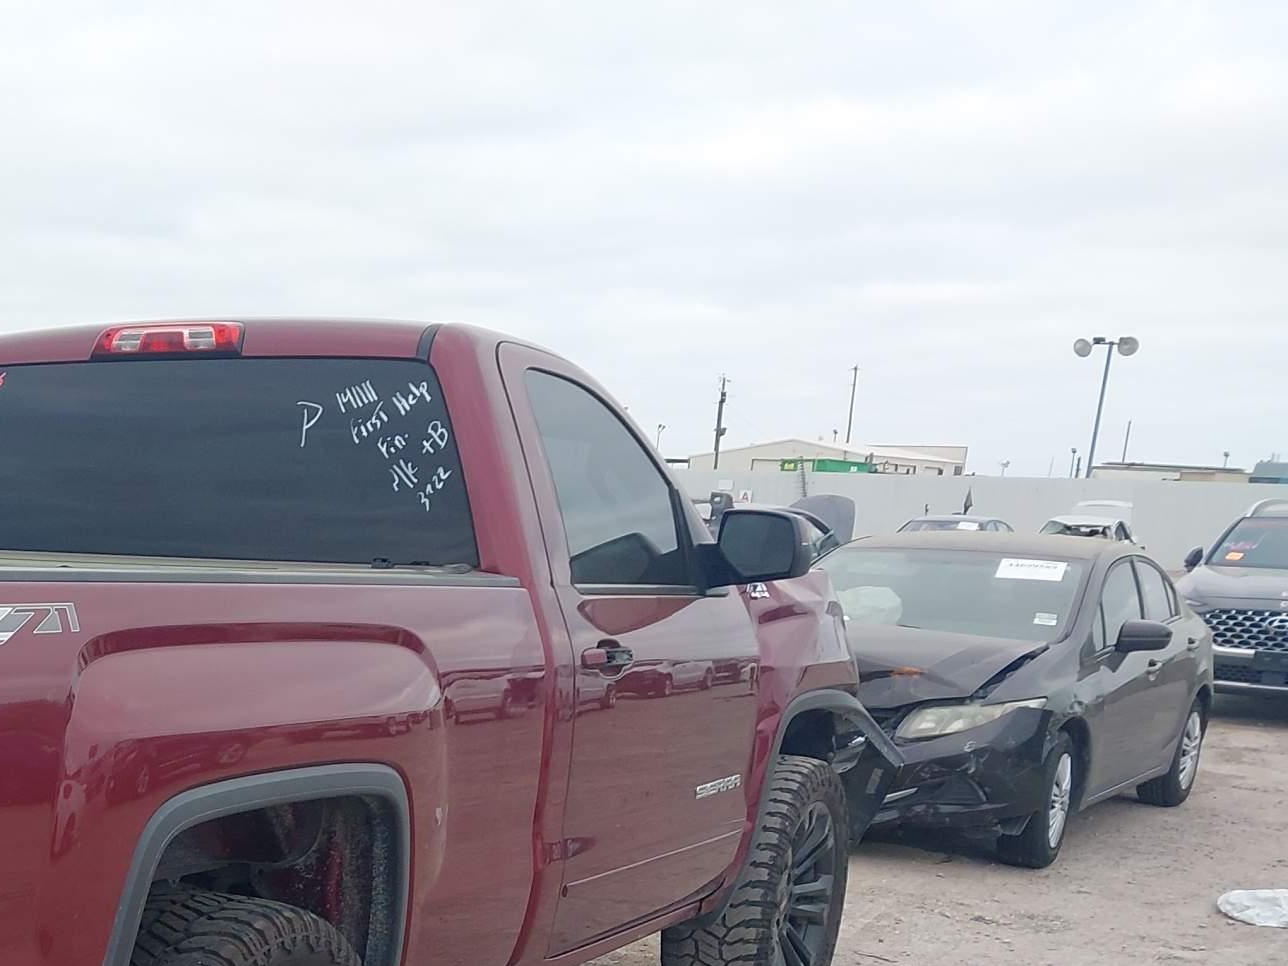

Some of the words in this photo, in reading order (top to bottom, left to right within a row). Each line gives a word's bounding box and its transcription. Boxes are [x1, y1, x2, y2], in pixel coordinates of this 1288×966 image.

[392, 381, 432, 416] Help
[296, 401, 323, 448] P
[695, 774, 741, 800] SIERRA
